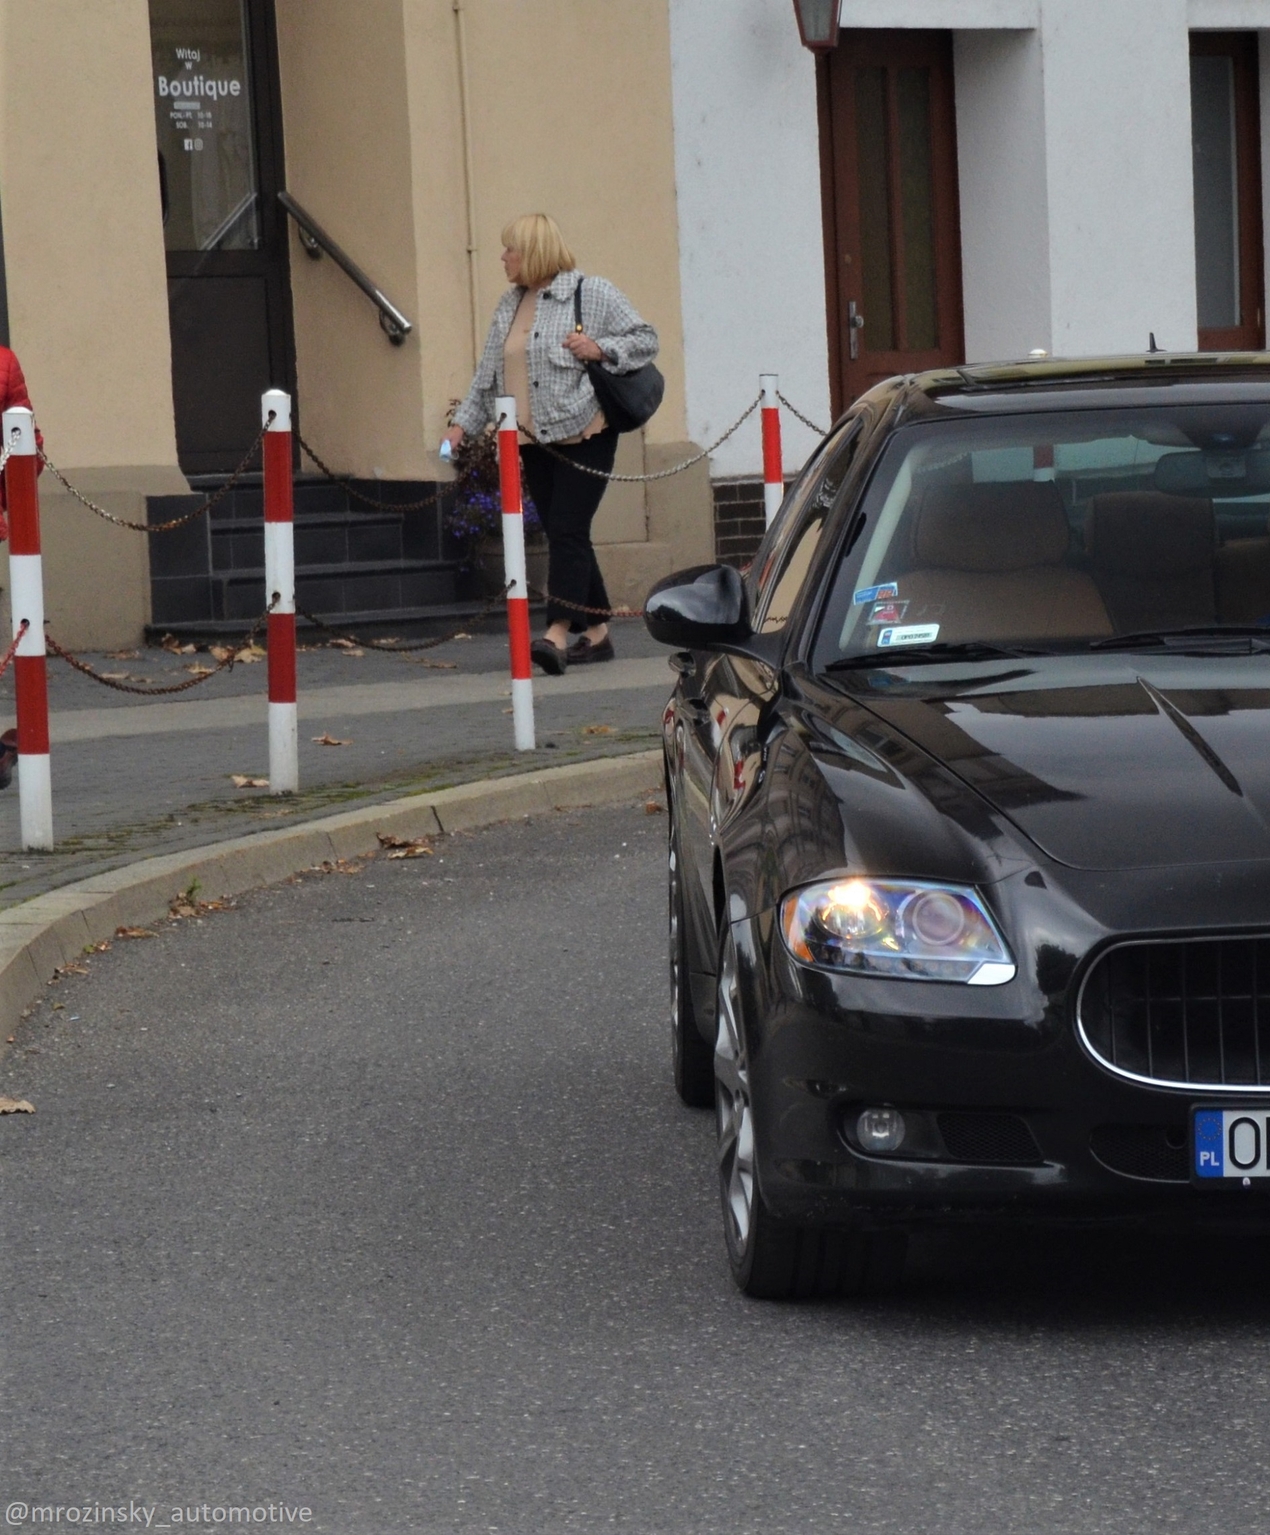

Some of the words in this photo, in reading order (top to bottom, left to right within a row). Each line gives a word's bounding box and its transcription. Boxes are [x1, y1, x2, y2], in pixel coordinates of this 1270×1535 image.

[176, 48, 200, 62] Witaj
[158, 75, 241, 101] Boutique
[1200, 1151, 1220, 1166] PL
